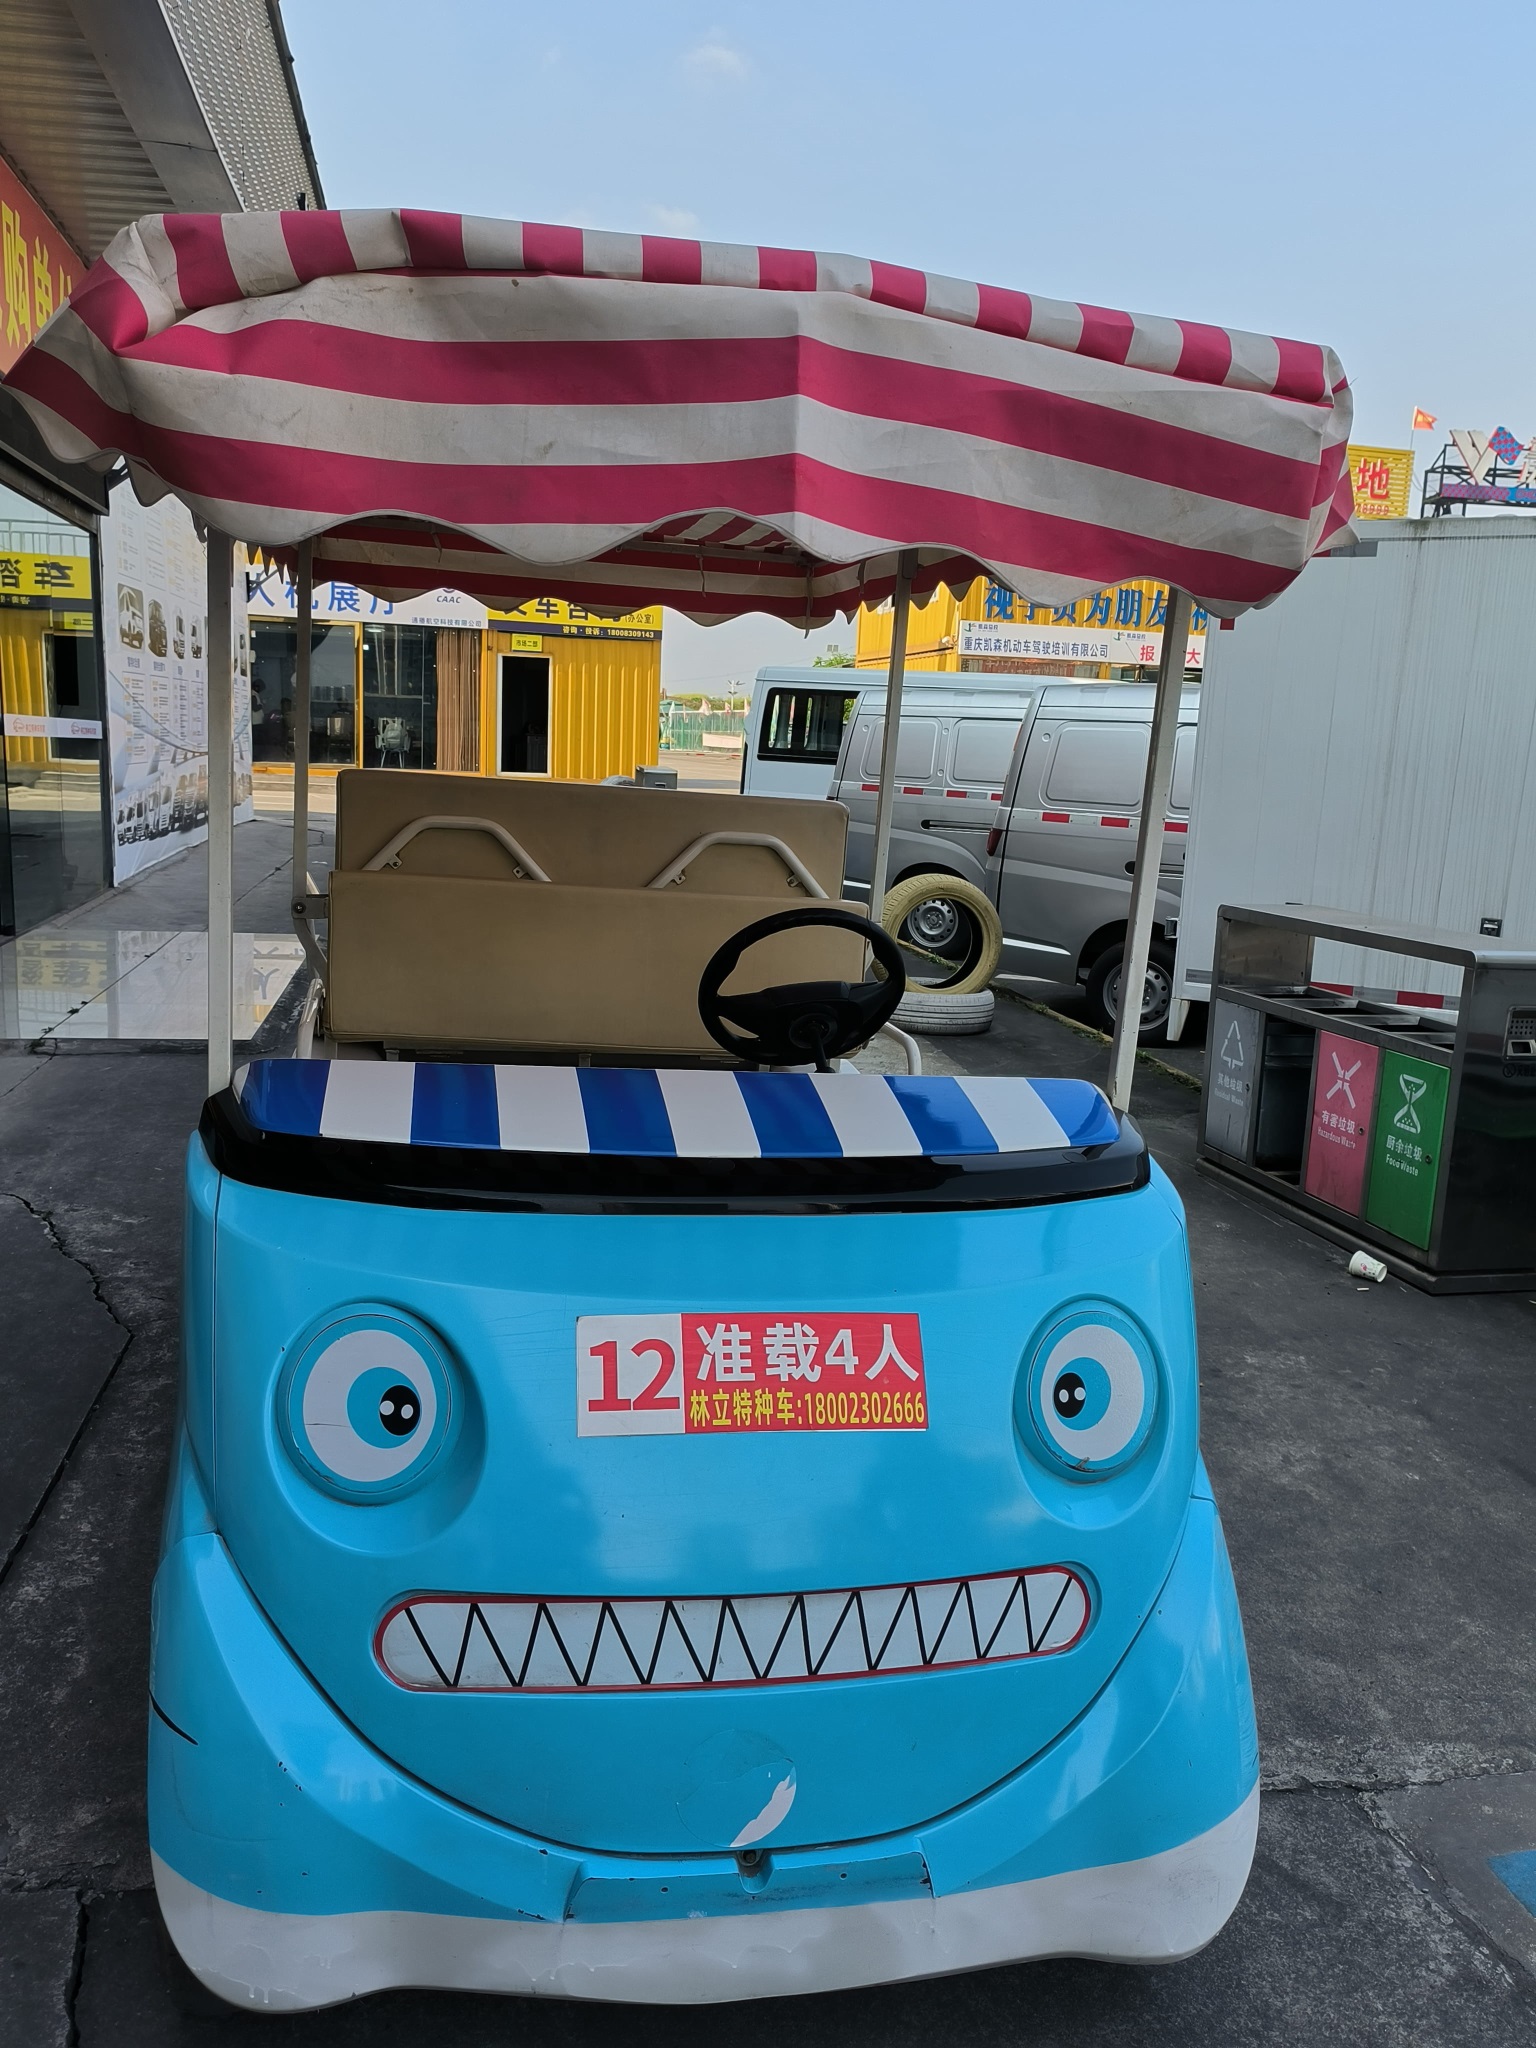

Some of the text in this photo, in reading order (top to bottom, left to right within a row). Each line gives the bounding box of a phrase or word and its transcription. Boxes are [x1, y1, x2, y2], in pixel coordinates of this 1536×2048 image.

[1356, 456, 1390, 500] 地
[436, 595, 461, 604] CAAC
[963, 636, 1109, 658] 重庆凯森机动车驾驶培训有限公司
[1217, 1072, 1243, 1094] 其他垃圾
[1321, 1110, 1356, 1135] 有害垃圾
[1317, 1126, 1341, 1145] Hazardous
[1385, 1134, 1423, 1162] 厨余垃圾
[1385, 1153, 1419, 1177] Food Waste
[696, 1322, 919, 1382] 准载4人
[588, 1338, 681, 1412] 12
